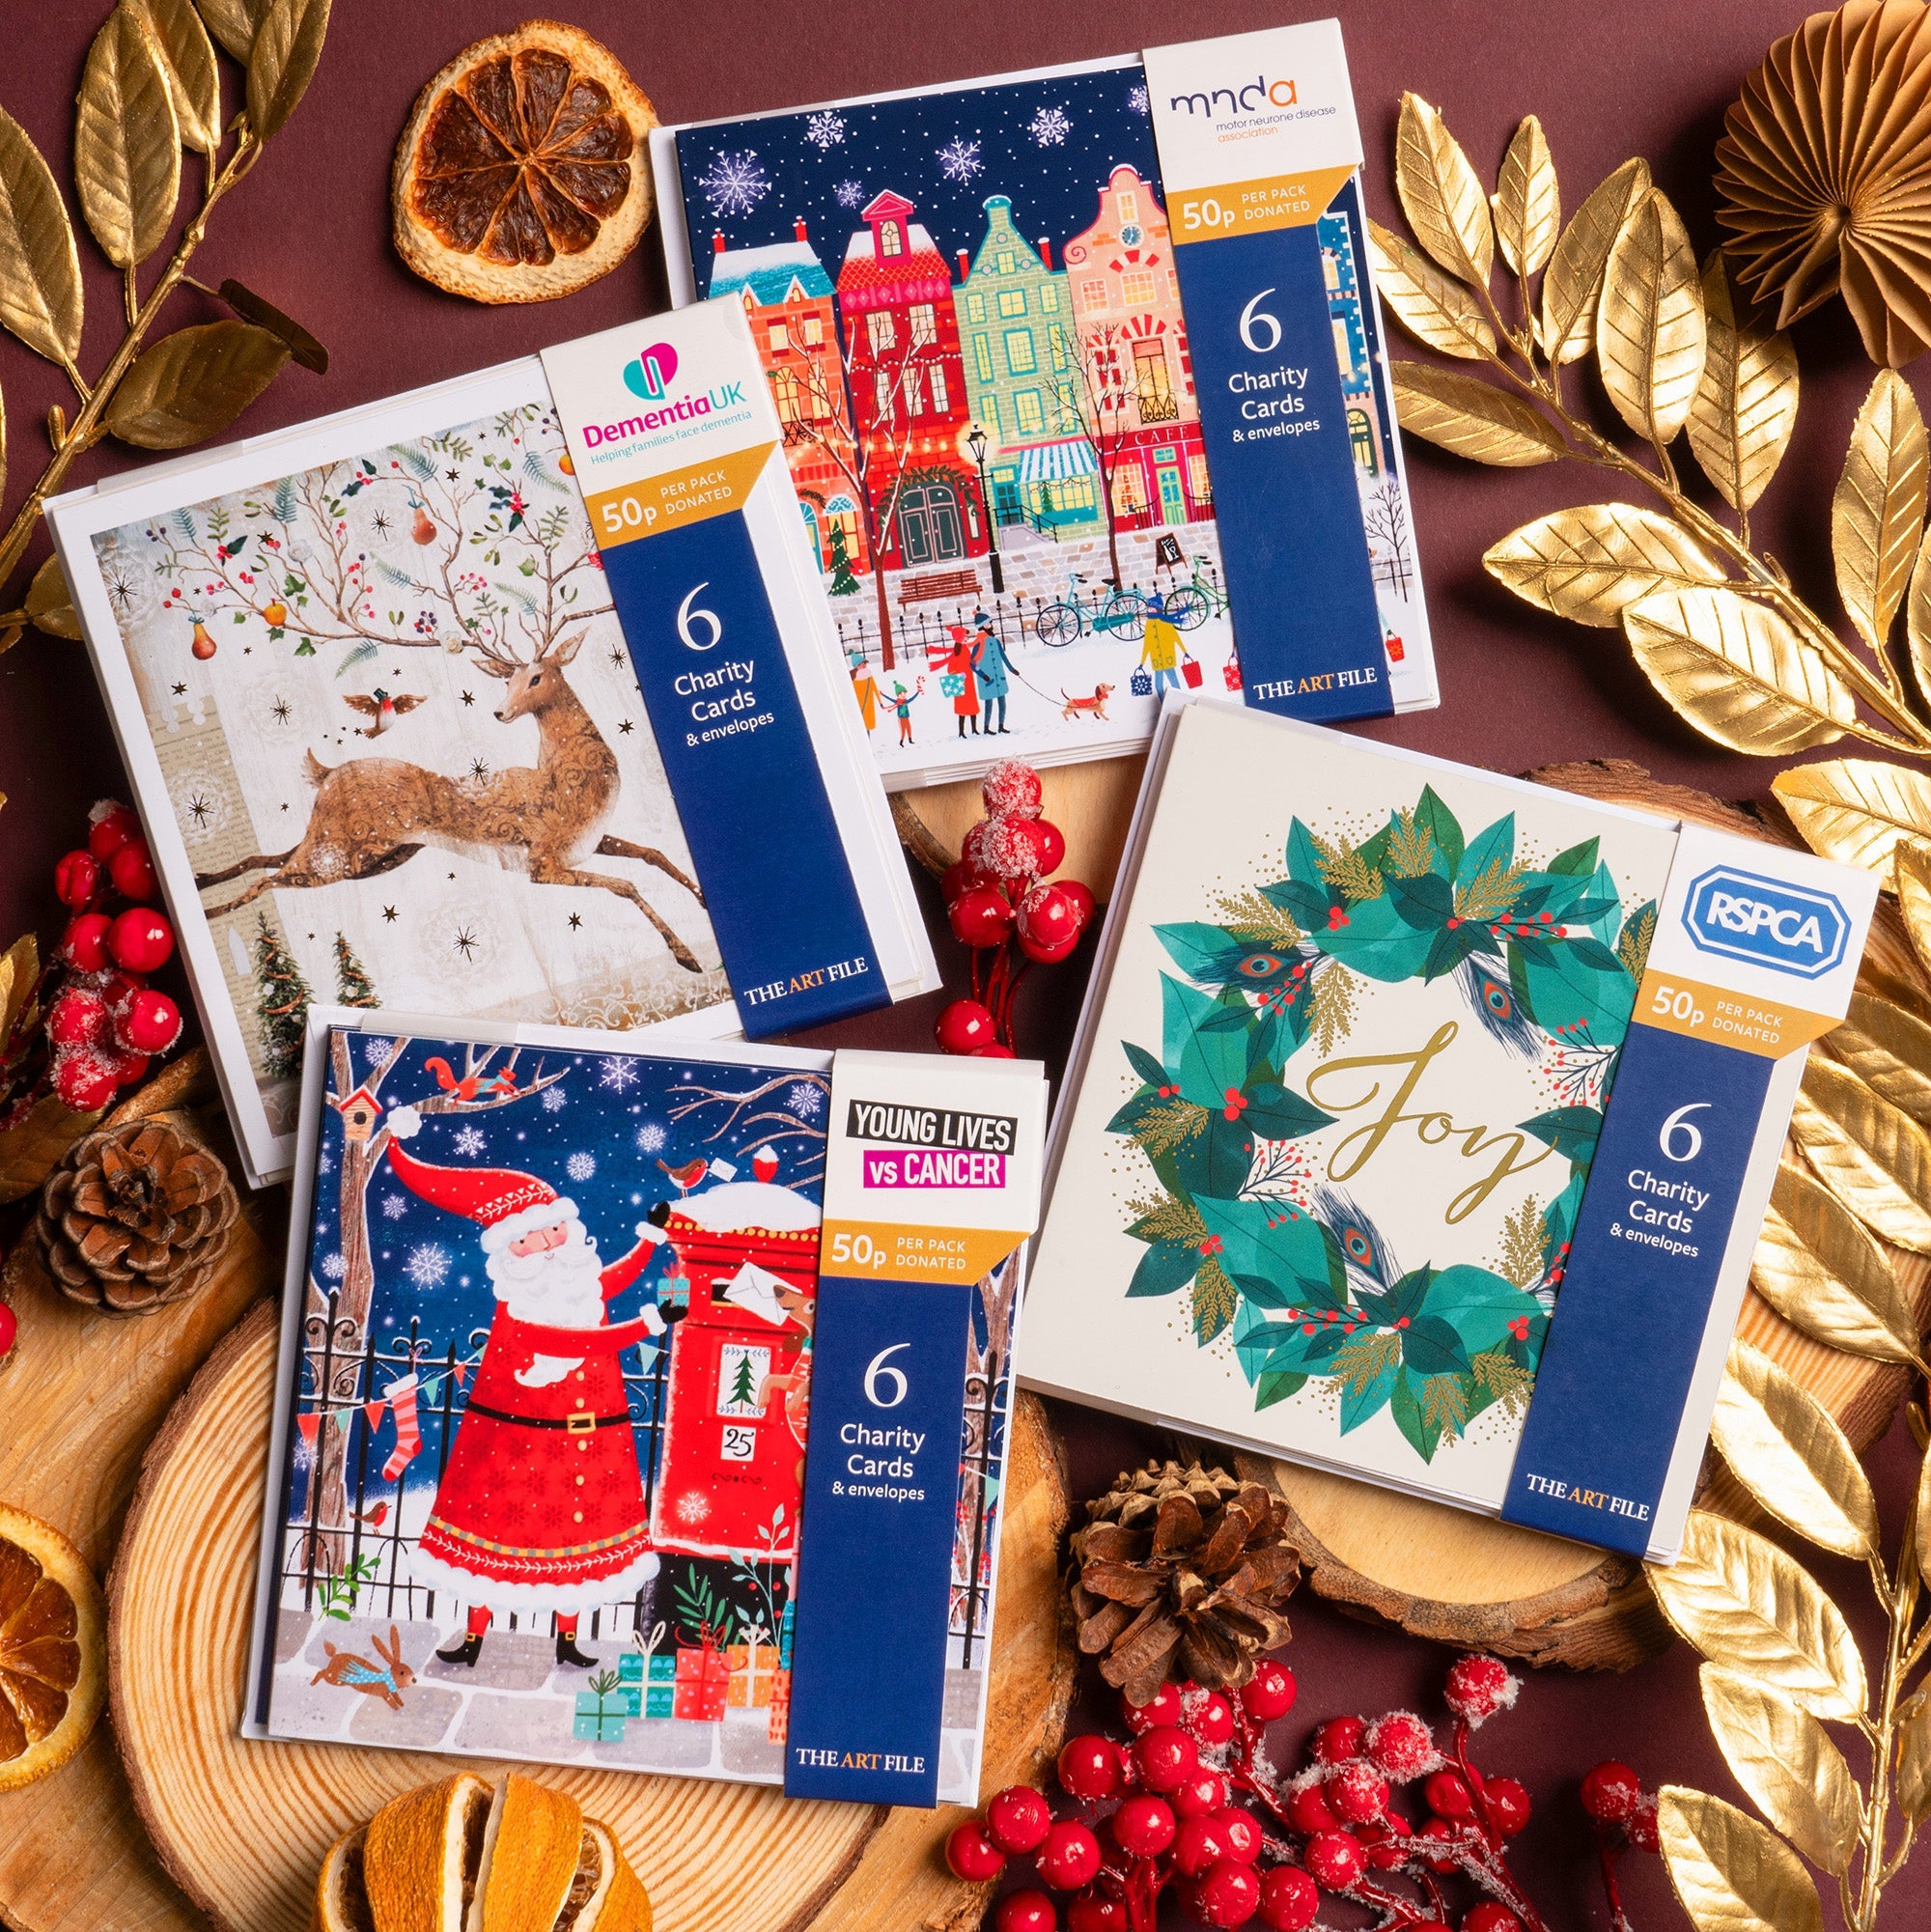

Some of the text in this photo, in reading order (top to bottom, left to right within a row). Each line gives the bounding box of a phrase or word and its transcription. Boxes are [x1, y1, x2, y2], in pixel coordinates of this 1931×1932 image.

[1170, 75, 1298, 118] mnda
[1216, 106, 1336, 131] motor neurone disease
[1217, 126, 1278, 143] association
[1242, 184, 1307, 204] PER PACK
[1244, 200, 1310, 220] DONATED
[1183, 198, 1236, 230] 50p
[1240, 288, 1282, 352] 6
[1228, 366, 1308, 393] Charity
[1241, 393, 1305, 420] Cards
[591, 410, 753, 465] Helping families face dementia
[1134, 426, 1189, 445] CAFE
[1232, 419, 1320, 442] & envelopes
[659, 469, 727, 498] PER PACK
[602, 496, 658, 533] 50p
[665, 486, 733, 515] DONATED
[677, 581, 722, 651] 6
[674, 659, 754, 696] Charity
[1253, 666, 1378, 701] THE ART FILE
[691, 688, 756, 721] Cards
[686, 713, 774, 747] & envelopes
[1706, 890, 1824, 954] RSPCA
[743, 957, 869, 1006] THE ART FILE
[1651, 985, 1705, 1027] 50p
[1716, 1000, 1784, 1028] PER PACK
[1712, 1017, 1780, 1045] DONATED
[854, 1104, 1012, 1152] YOUNG LIVES
[1306, 1021, 1559, 1225] Joy
[1659, 1103, 1712, 1162] 6
[869, 1153, 1000, 1185] vs CANCER
[1628, 1169, 1710, 1212] Charity
[1629, 1200, 1693, 1234] Cards
[831, 1233, 887, 1270] 50p
[897, 1237, 966, 1253] PER PACK
[1609, 1222, 1699, 1258] & envelopes
[895, 1254, 966, 1270] DONATED
[863, 1342, 910, 1408] 6
[724, 1428, 755, 1457] 25
[840, 1422, 926, 1454] Charity
[847, 1454, 913, 1478] Cards
[831, 1480, 925, 1503] & envelopes
[1526, 1472, 1650, 1522] THE ART FILE
[796, 1748, 925, 1774] THE ART FILE
